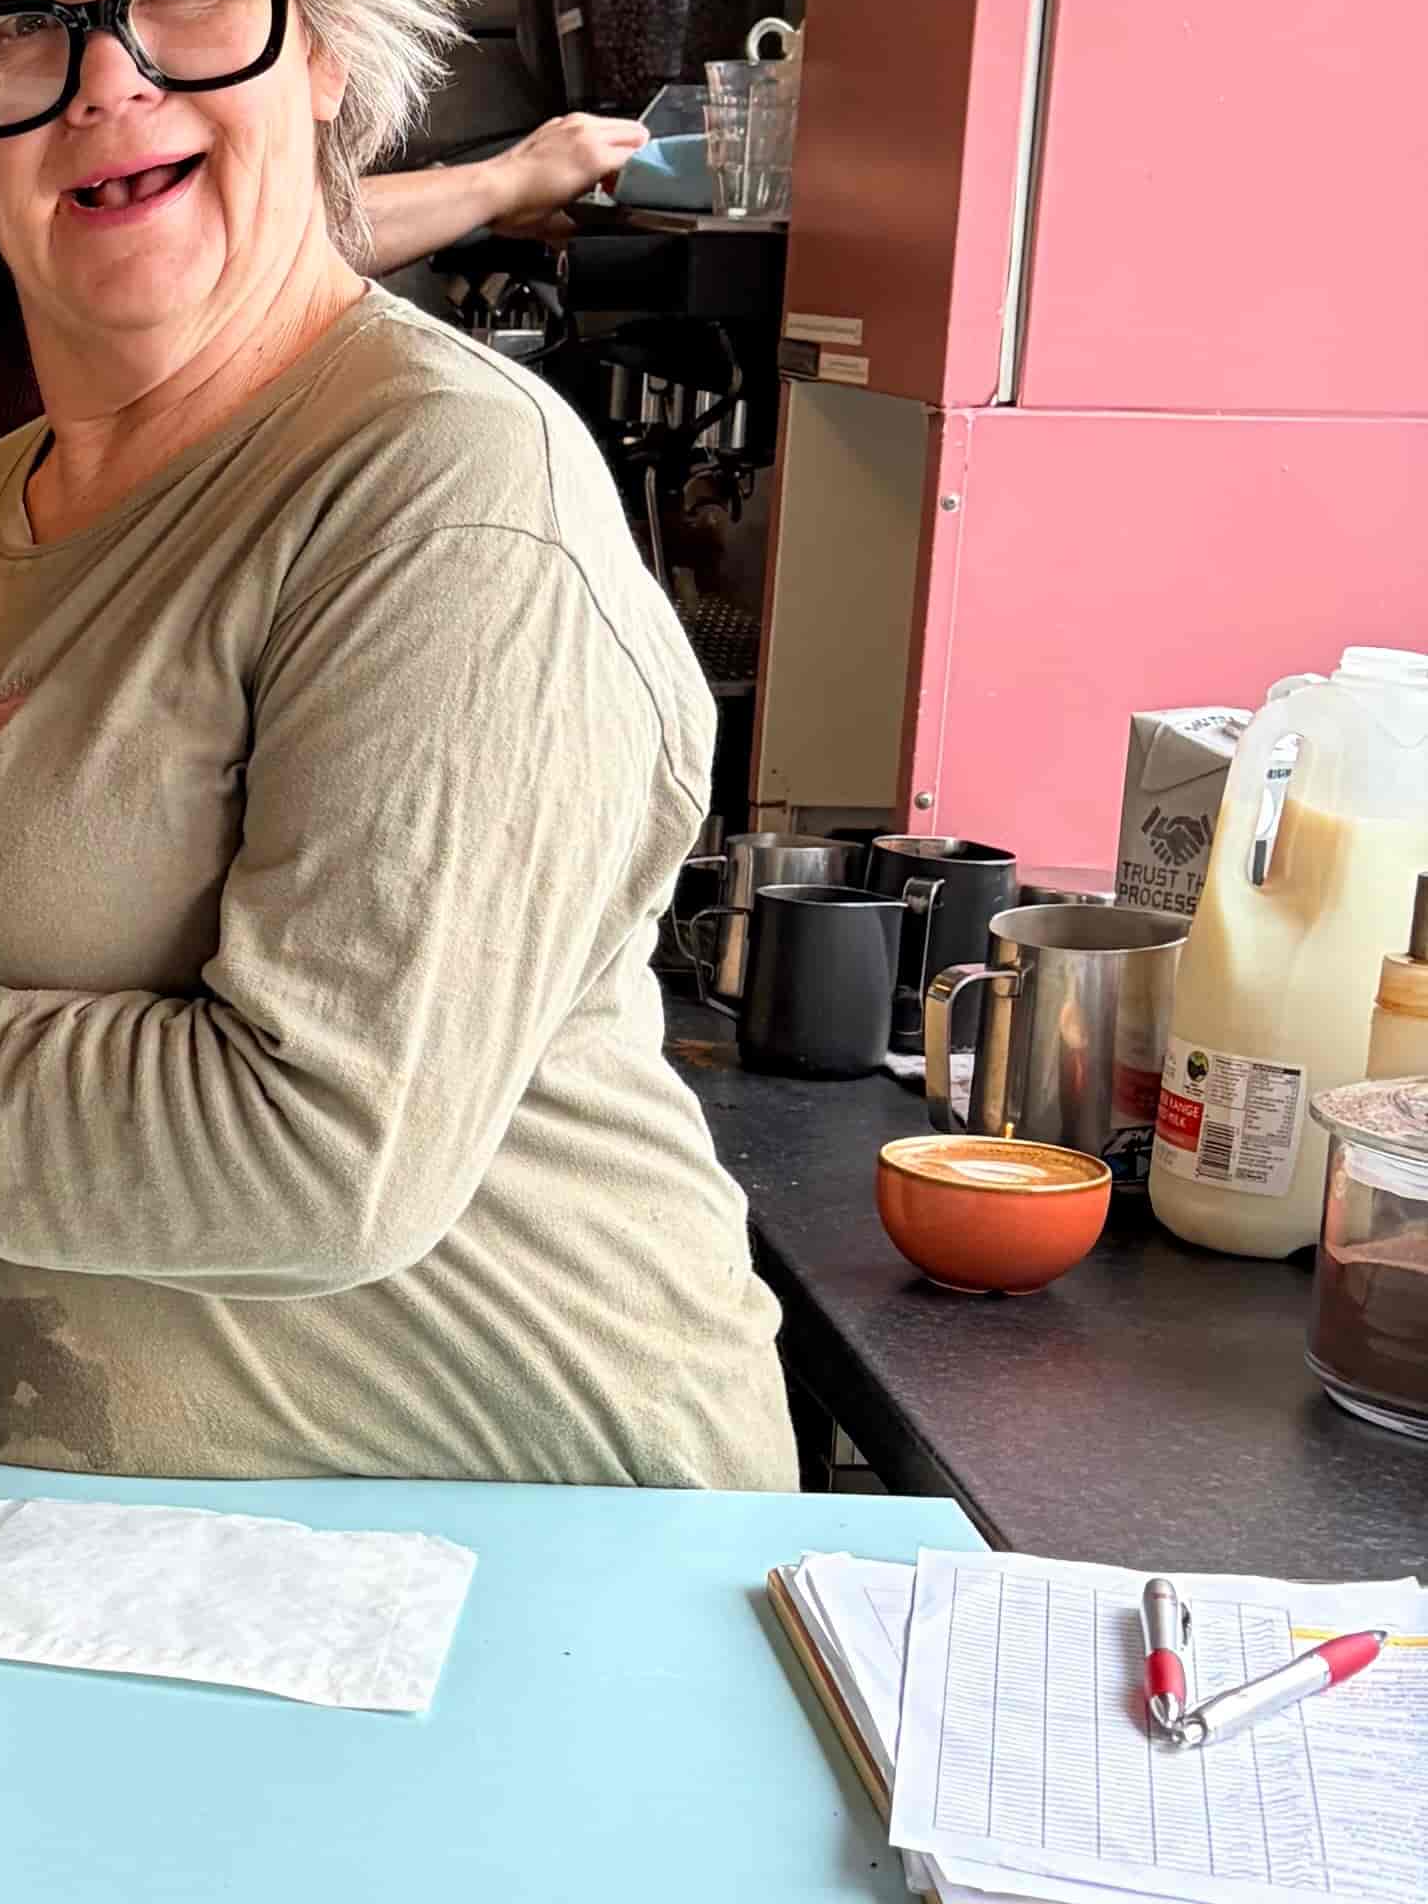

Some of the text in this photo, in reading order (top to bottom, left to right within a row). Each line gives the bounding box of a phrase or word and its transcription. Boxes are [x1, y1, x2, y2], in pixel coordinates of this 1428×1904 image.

[1122, 861, 1205, 894] TRUST TH
[1118, 883, 1199, 914] PROCESS
